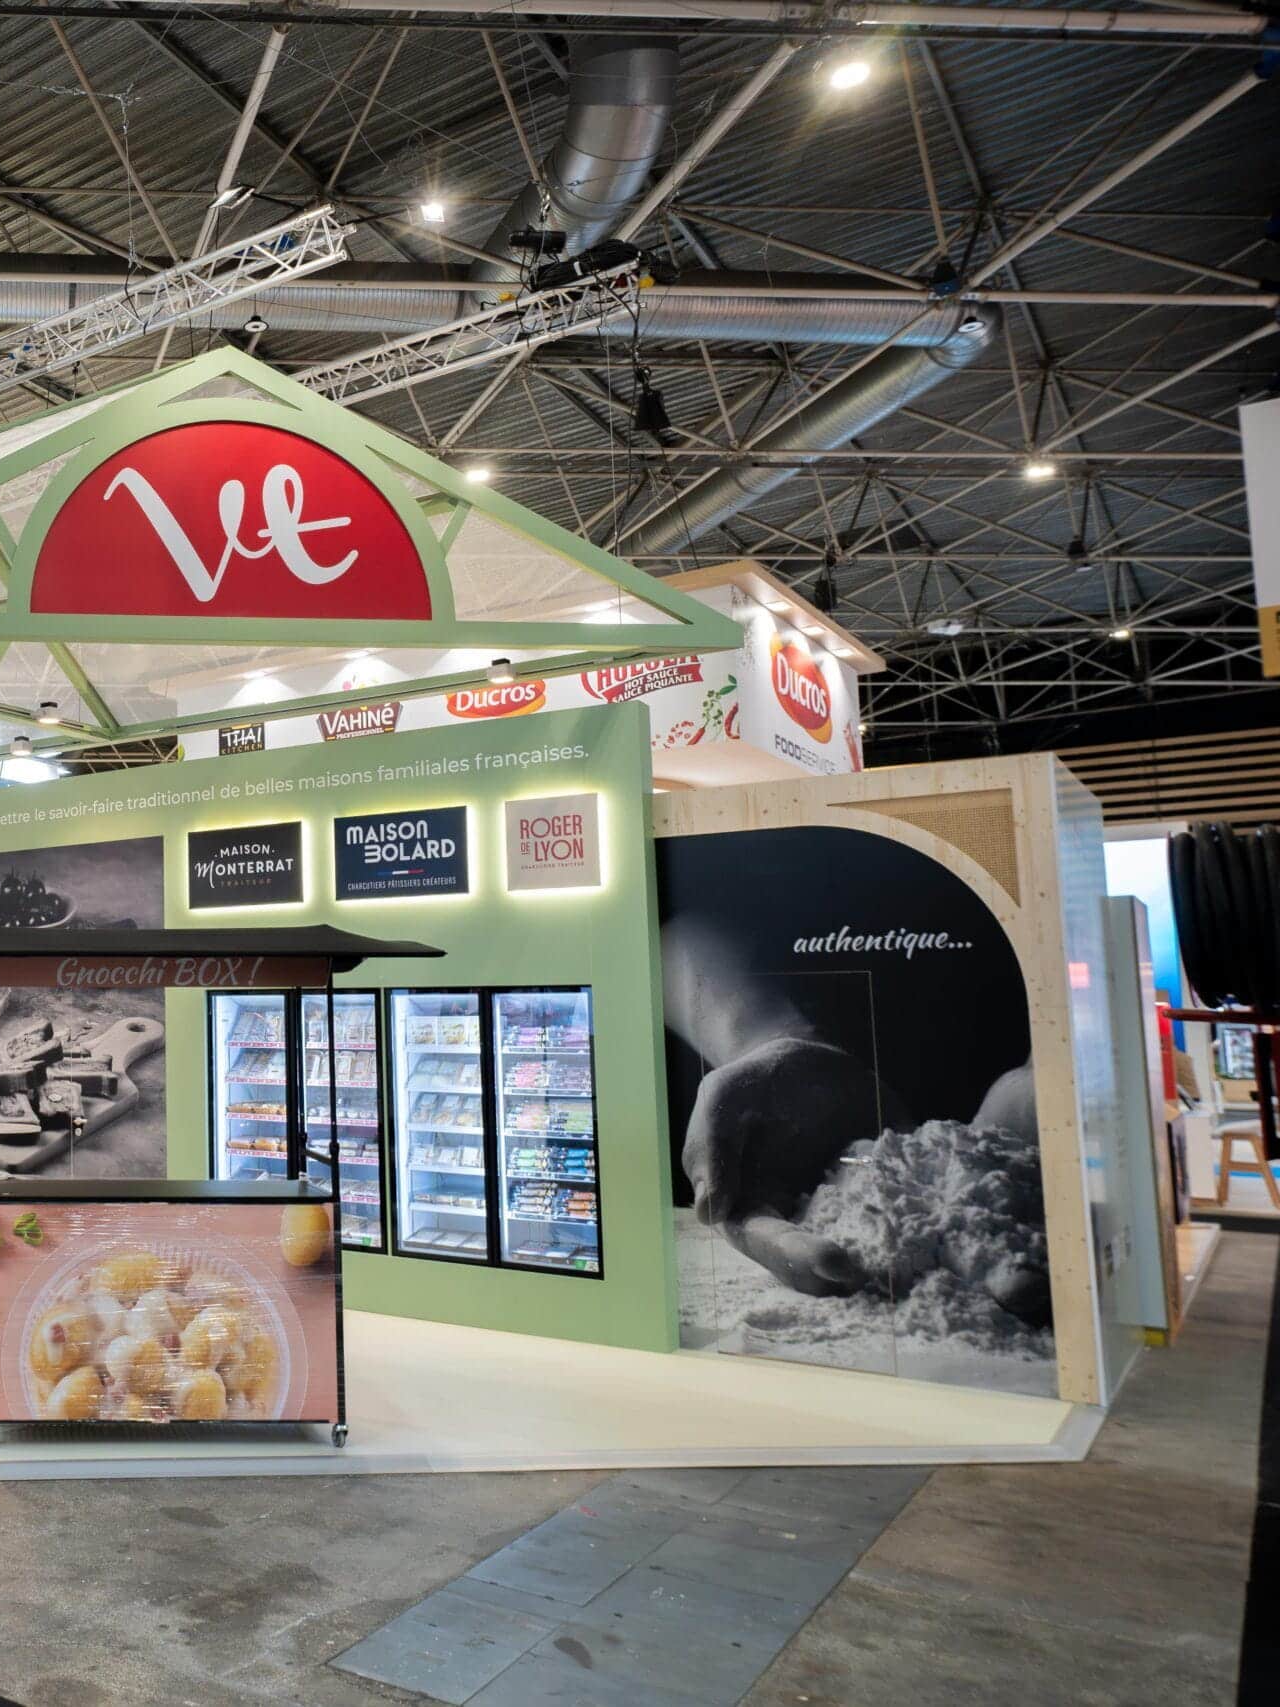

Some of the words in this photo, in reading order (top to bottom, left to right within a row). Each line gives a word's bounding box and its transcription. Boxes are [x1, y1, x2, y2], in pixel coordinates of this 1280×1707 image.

[612, 686, 642, 703] SAUCE
[645, 674, 694, 691] PIQUANTE
[624, 677, 644, 690] HOT
[646, 668, 679, 681] SAUCE
[777, 652, 827, 718] Ducros
[456, 684, 537, 711] Ducros
[221, 743, 263, 755] KITCHEN
[222, 727, 262, 747] THAI
[34, 807, 46, 821] le
[48, 799, 124, 819] savoir-faire
[127, 786, 215, 810] traditionnel
[220, 783, 240, 798] de
[245, 777, 294, 796] belles
[299, 769, 372, 790] maisons
[376, 756, 470, 782] familiales
[474, 744, 590, 770] françaises.
[345, 819, 429, 845] MAISON
[520, 814, 583, 839] ROGER
[220, 843, 271, 858] MAISON
[364, 838, 456, 864] BOLARD
[534, 838, 584, 861] LYON
[194, 858, 294, 889] MONTERRAT
[793, 925, 973, 959] authentique...
[56, 956, 168, 986] Gnocchi
[174, 956, 244, 986] BOX
